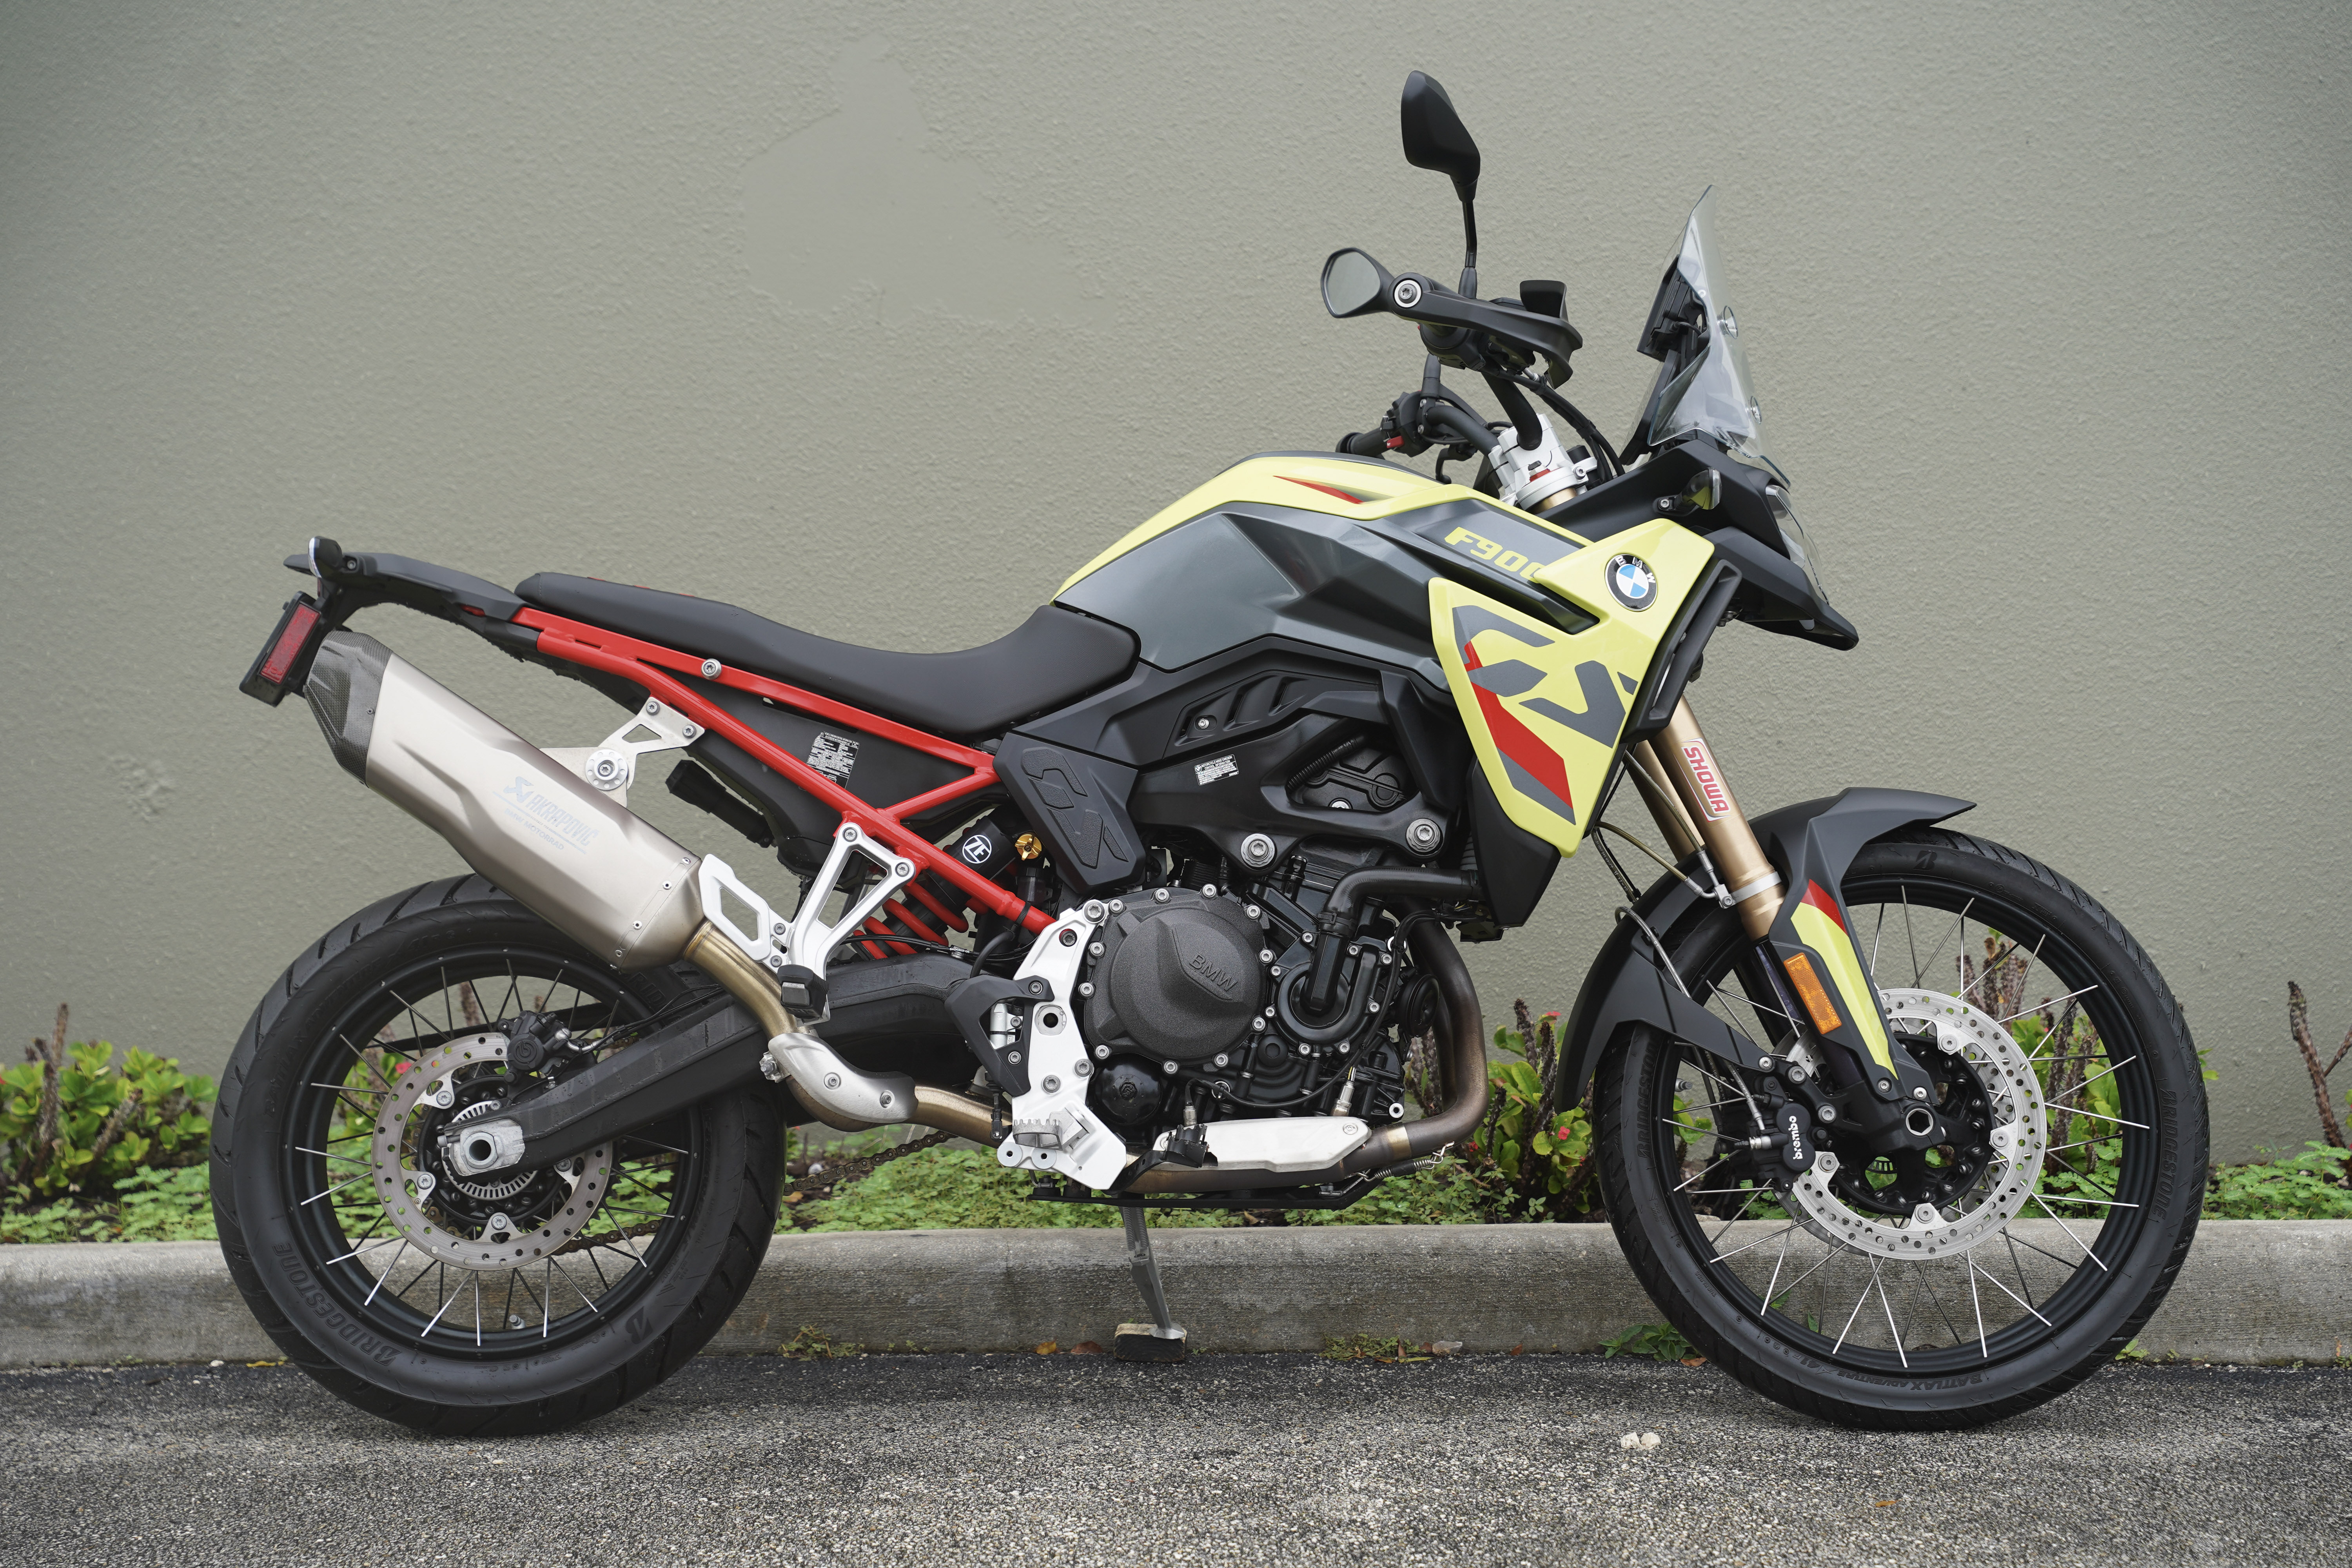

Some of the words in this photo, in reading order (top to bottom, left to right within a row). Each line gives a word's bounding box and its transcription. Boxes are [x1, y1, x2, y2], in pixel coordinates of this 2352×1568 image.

[1615, 556, 1656, 584] BMW
[1681, 745, 1731, 814] SHOWA
[504, 808, 524, 825] BMW
[524, 821, 564, 851] MOTORRAD
[964, 836, 991, 864] ZF
[1190, 955, 1237, 991] BMW
[1788, 1115, 1803, 1160] brembo
[2152, 1088, 2179, 1220] BRIDGESTONE
[272, 1242, 402, 1367] BRIDGESTONE
[1837, 1369, 1909, 1388] ADVENTURE
[1910, 1373, 1983, 1390] BATTLAX
